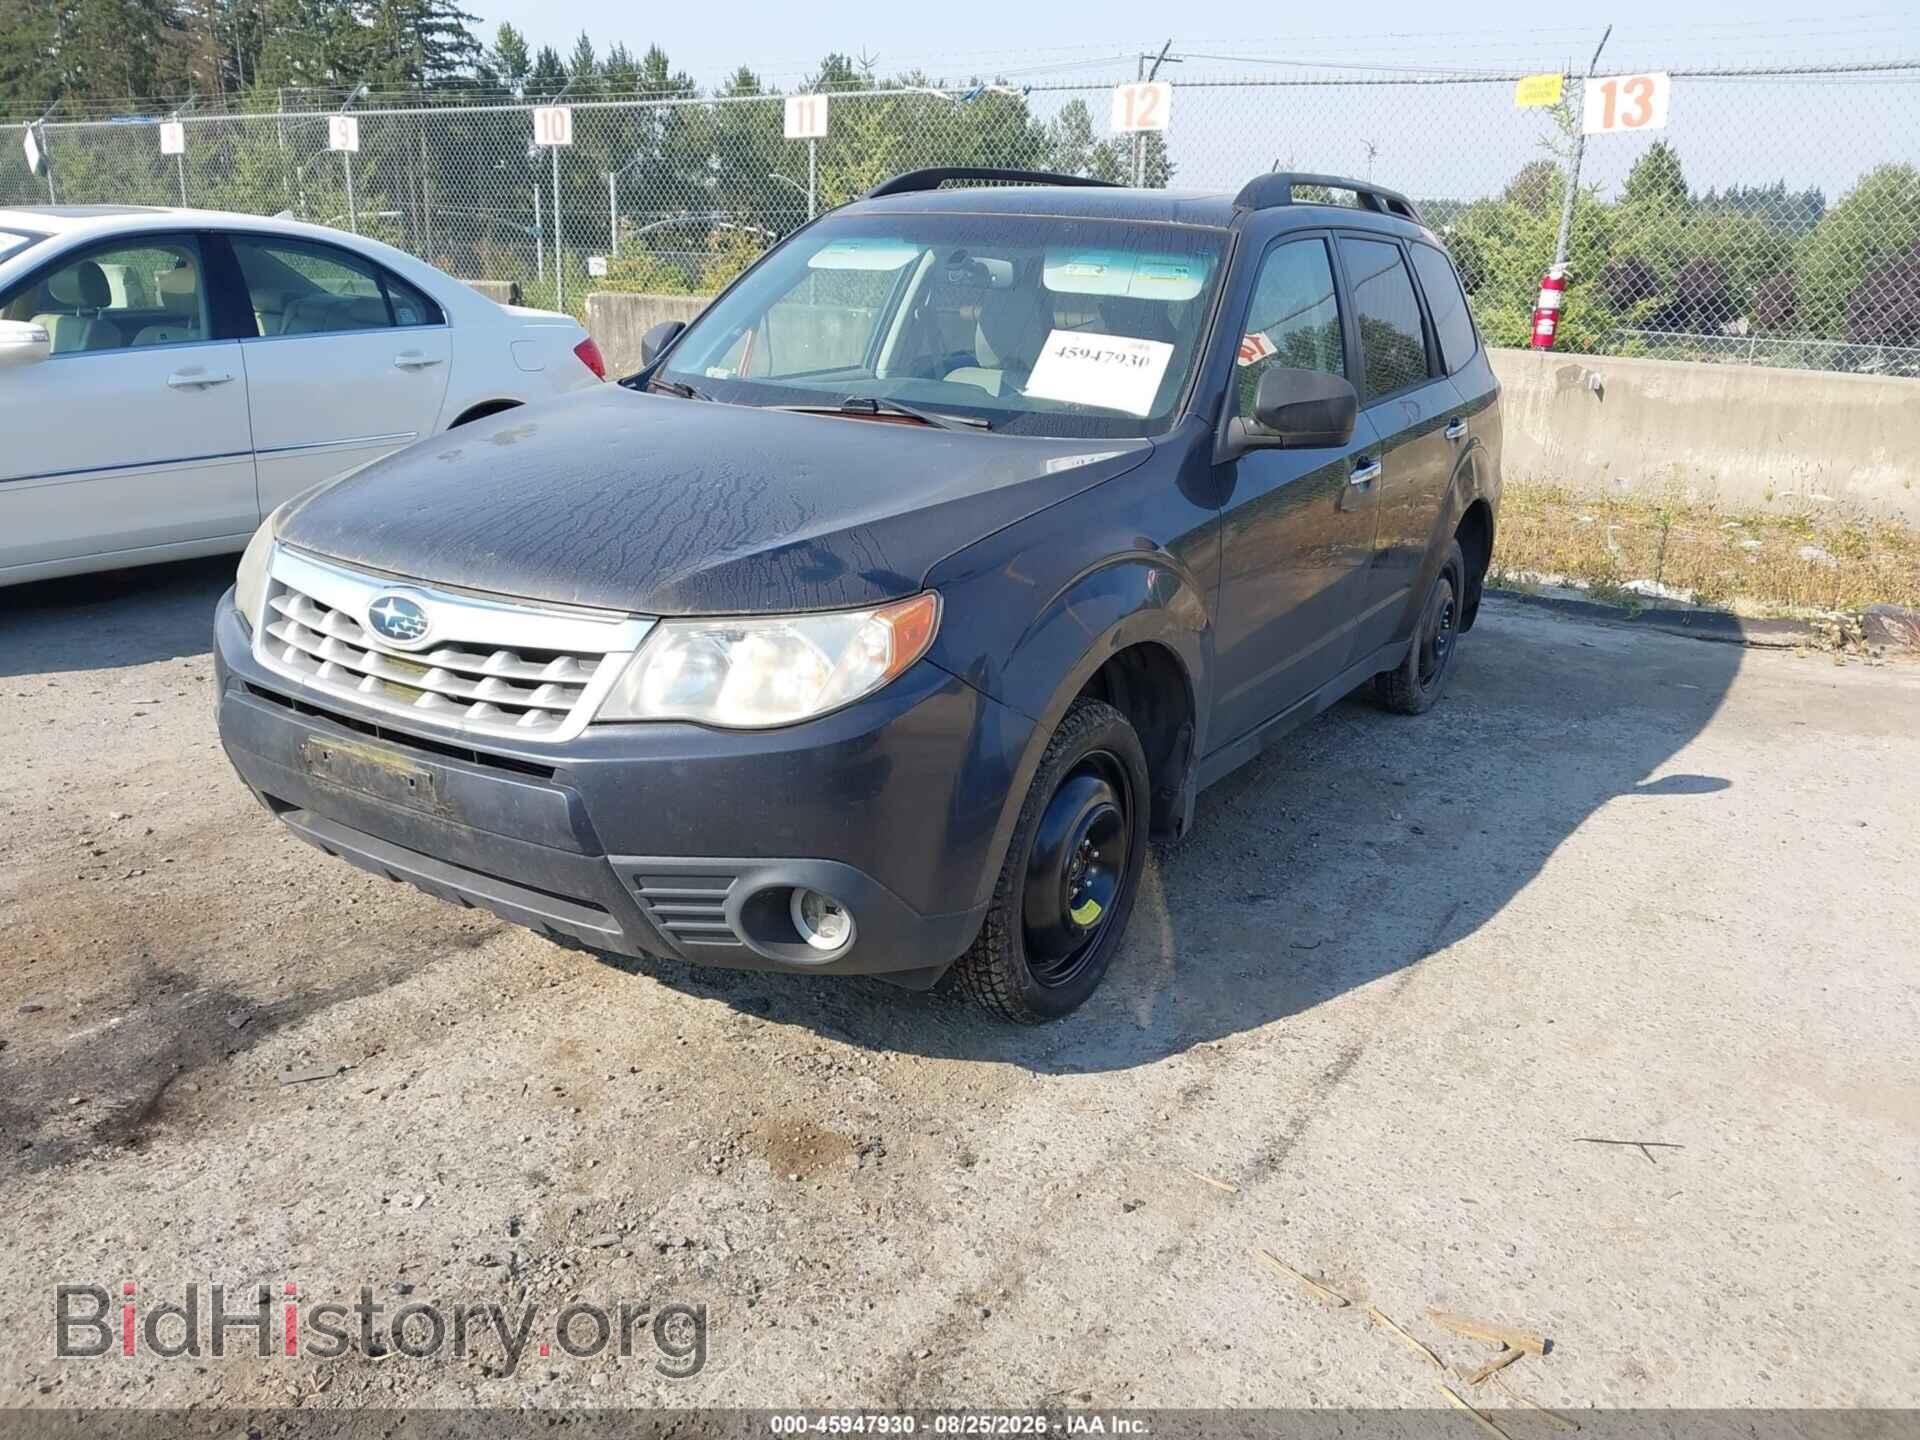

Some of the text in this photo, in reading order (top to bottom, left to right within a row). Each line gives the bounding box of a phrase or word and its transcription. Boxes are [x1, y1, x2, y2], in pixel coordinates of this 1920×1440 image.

[797, 101, 816, 132] 11
[1123, 86, 1160, 128] 12
[1601, 76, 1654, 129] 13
[338, 119, 349, 148] 9
[542, 110, 565, 141] 10
[1055, 346, 1150, 368] 45947930
